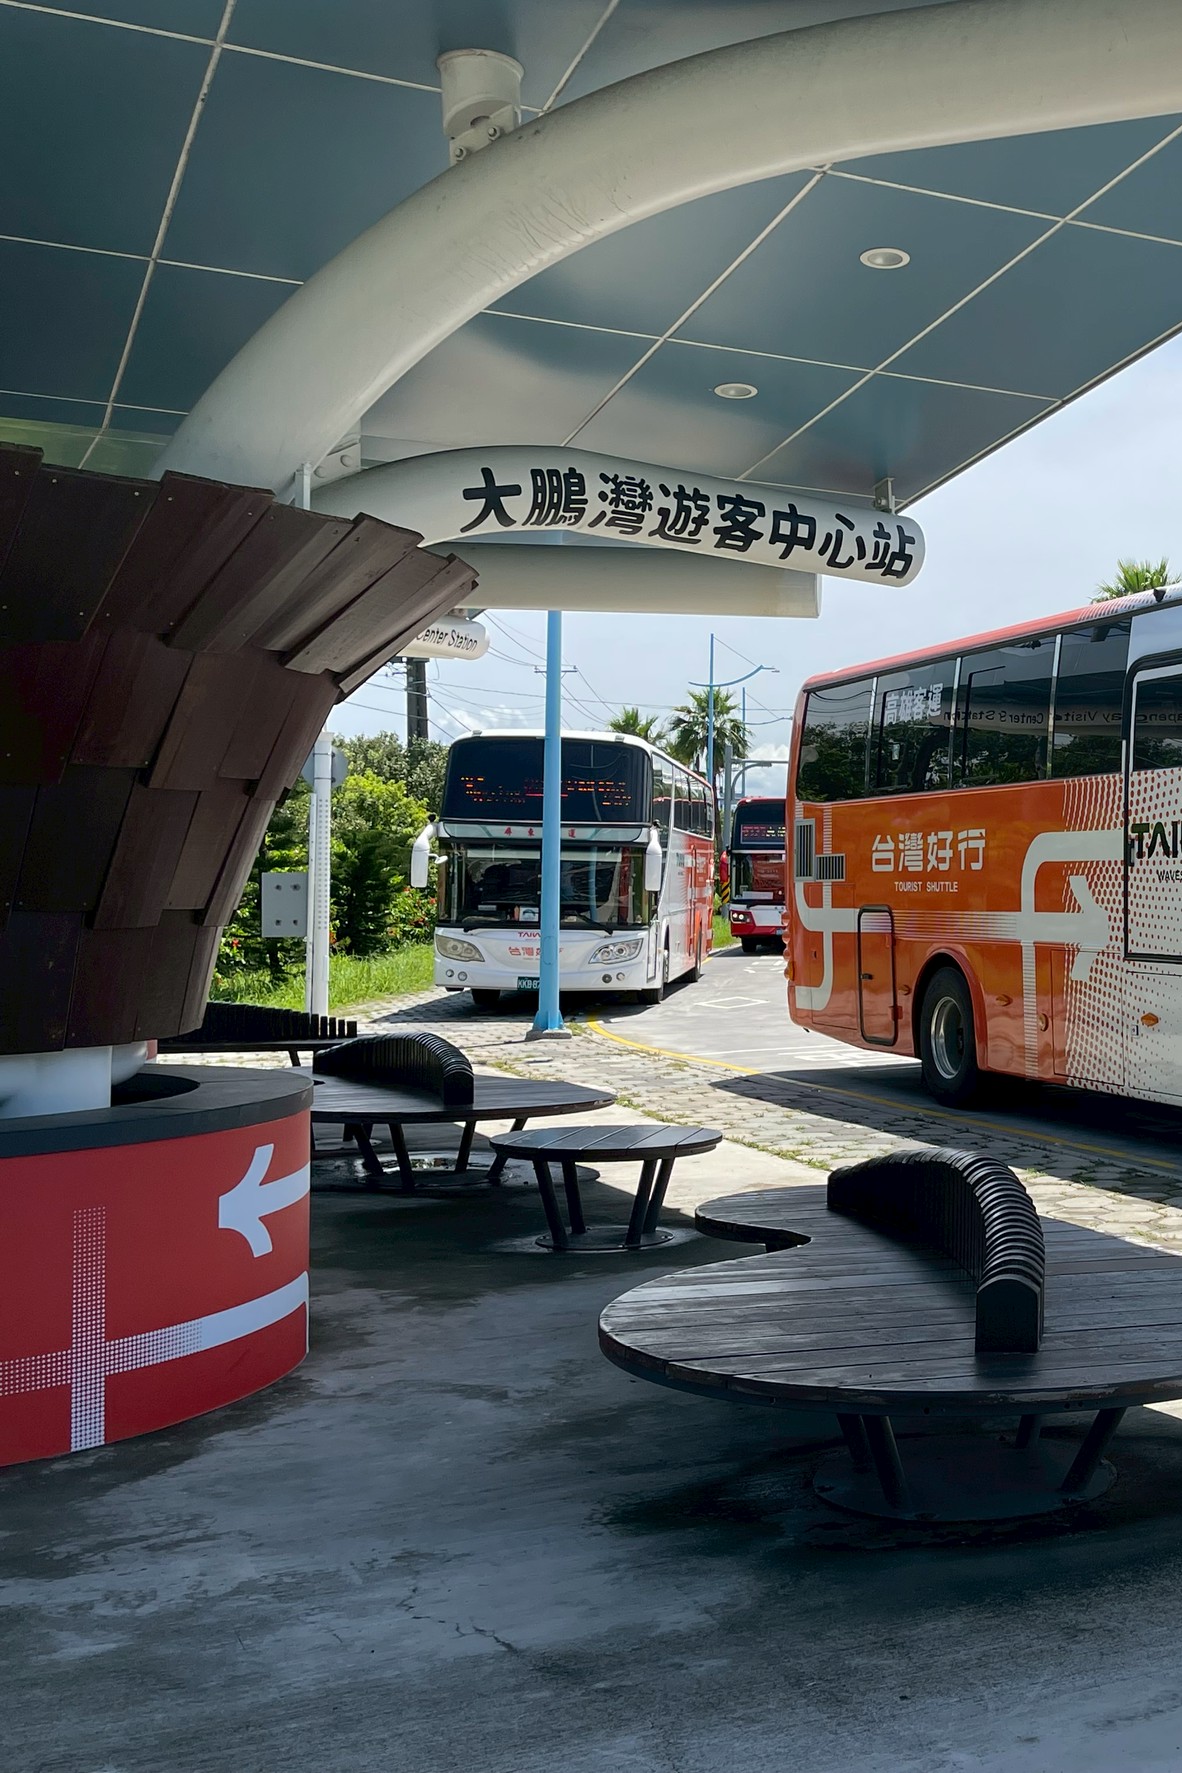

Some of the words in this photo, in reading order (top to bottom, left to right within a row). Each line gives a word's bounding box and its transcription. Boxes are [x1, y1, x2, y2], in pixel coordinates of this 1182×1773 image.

[460, 467, 917, 579] 大鵬灣遊客中心站
[448, 629, 478, 652] Station
[884, 683, 943, 726] 高雄客運
[871, 828, 986, 872] 台灣好行
[894, 881, 922, 892] TOURIST
[926, 881, 958, 892] SHUTTLE
